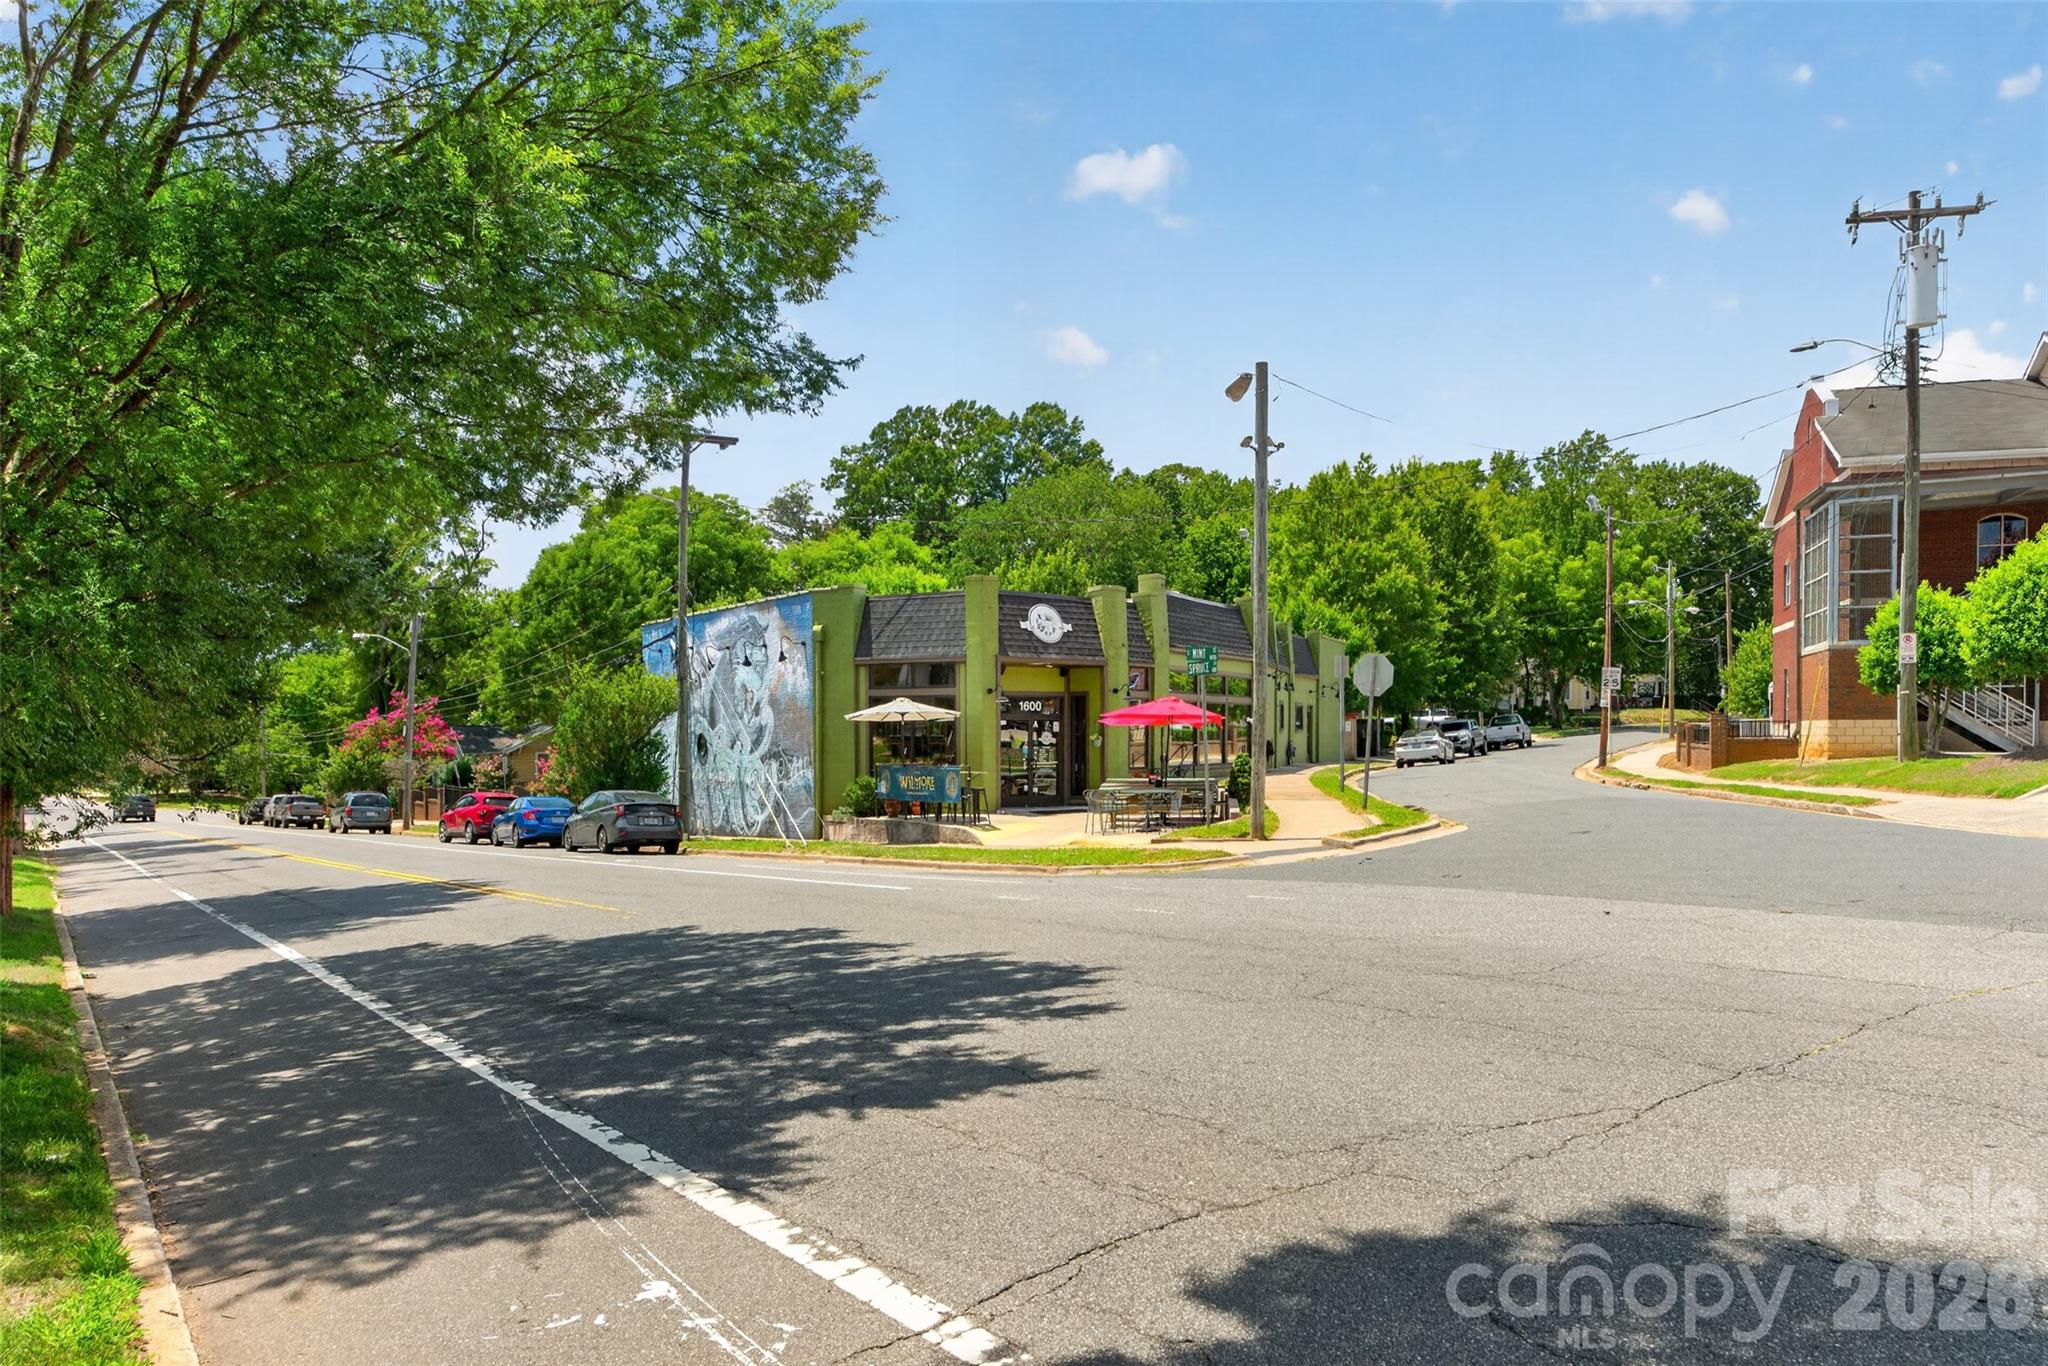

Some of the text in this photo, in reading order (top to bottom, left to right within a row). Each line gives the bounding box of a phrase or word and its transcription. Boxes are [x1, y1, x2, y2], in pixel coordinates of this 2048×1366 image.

[1192, 648, 1206, 659] MINT
[1188, 661, 1210, 675] SPRUCE
[1603, 678, 1620, 688] 25
[1018, 700, 1042, 712] 1600
